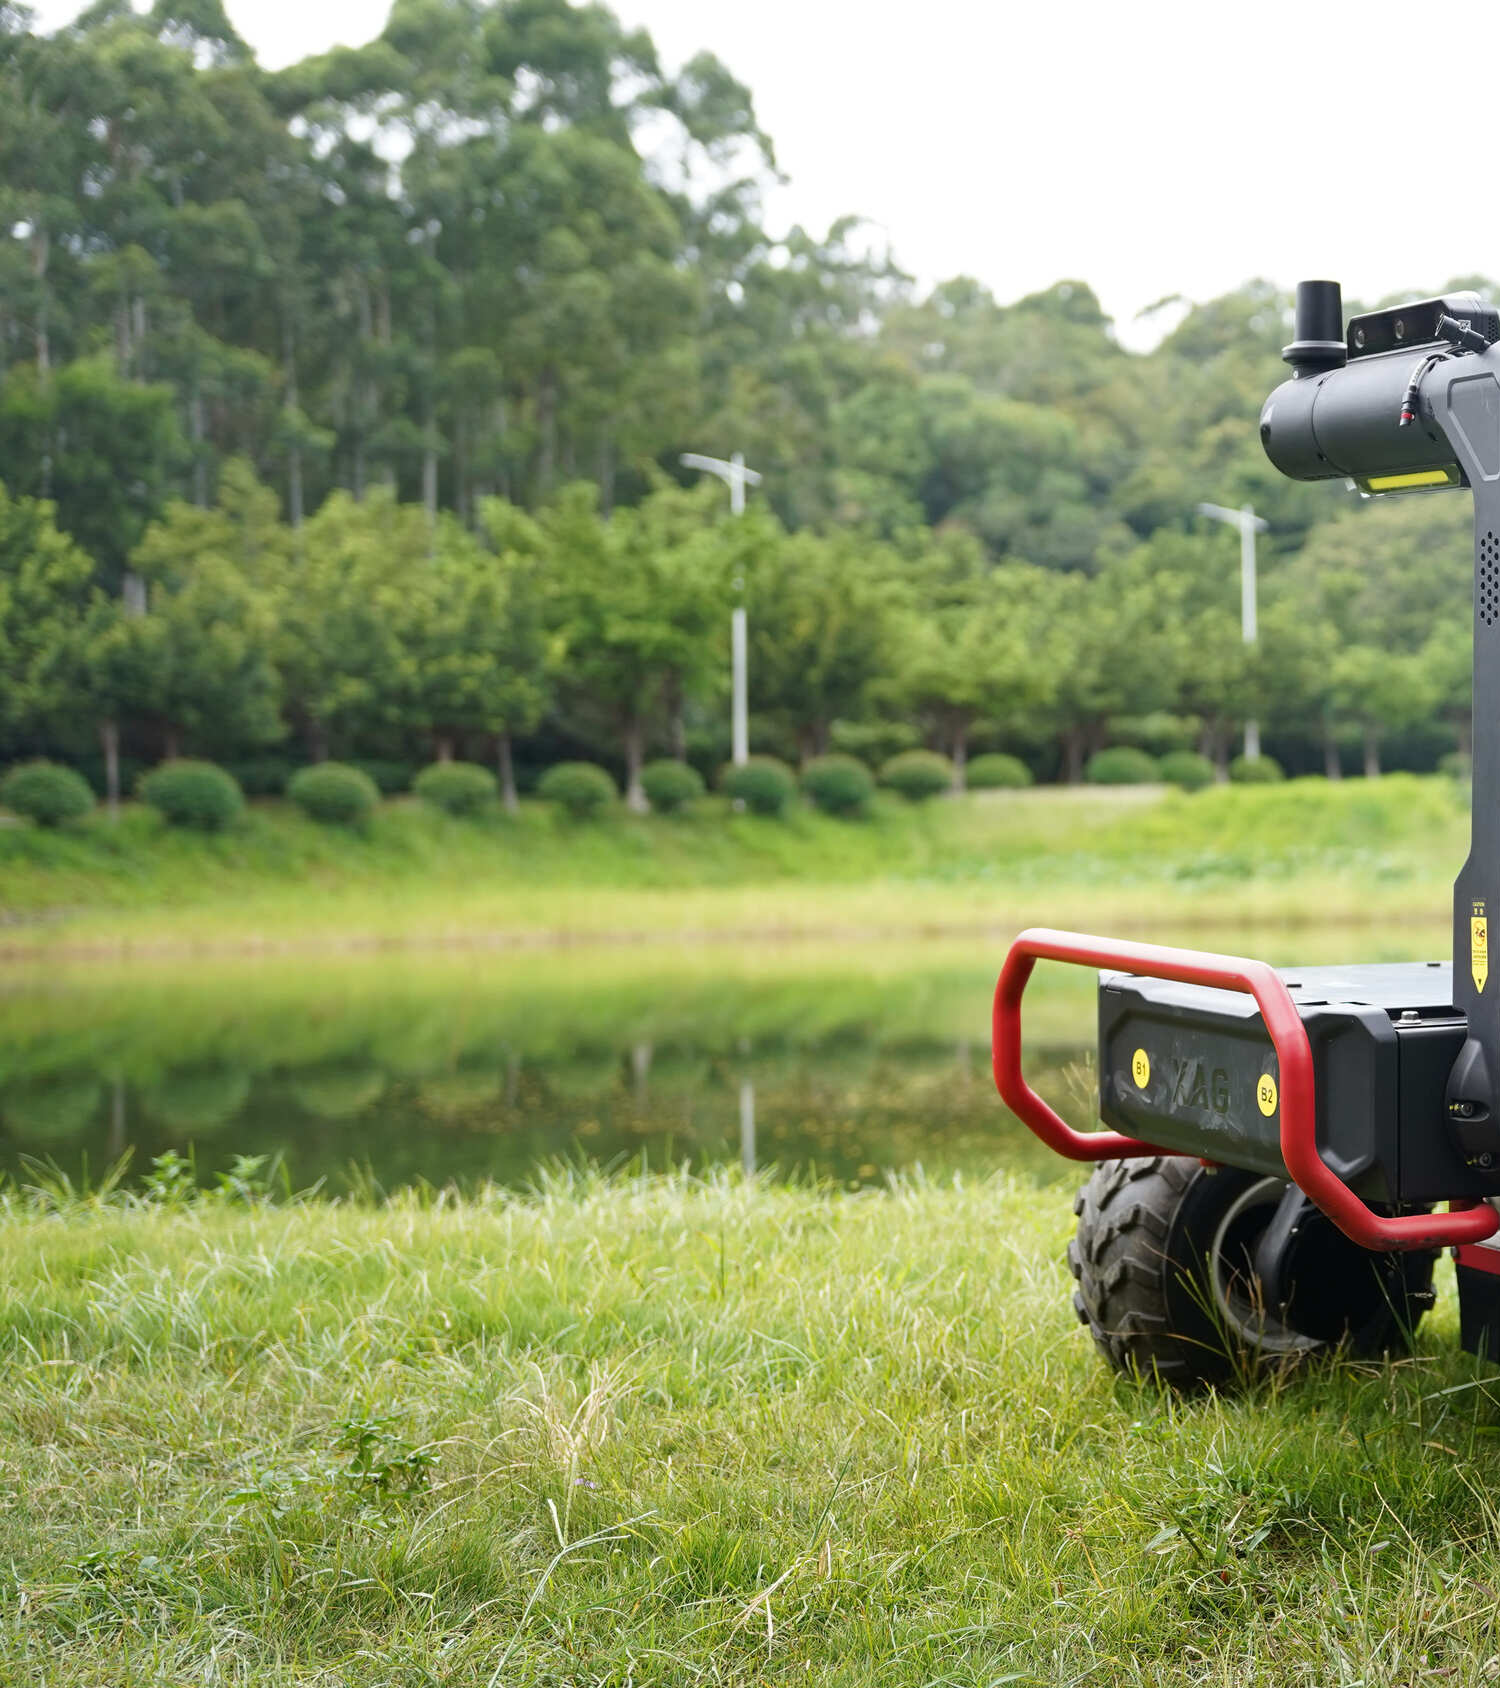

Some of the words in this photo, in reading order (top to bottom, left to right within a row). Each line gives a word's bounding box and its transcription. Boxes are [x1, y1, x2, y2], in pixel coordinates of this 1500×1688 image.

[1136, 1061, 1147, 1077] B1
[1171, 1057, 1230, 1114] XAG
[1260, 1087, 1273, 1104] B2
